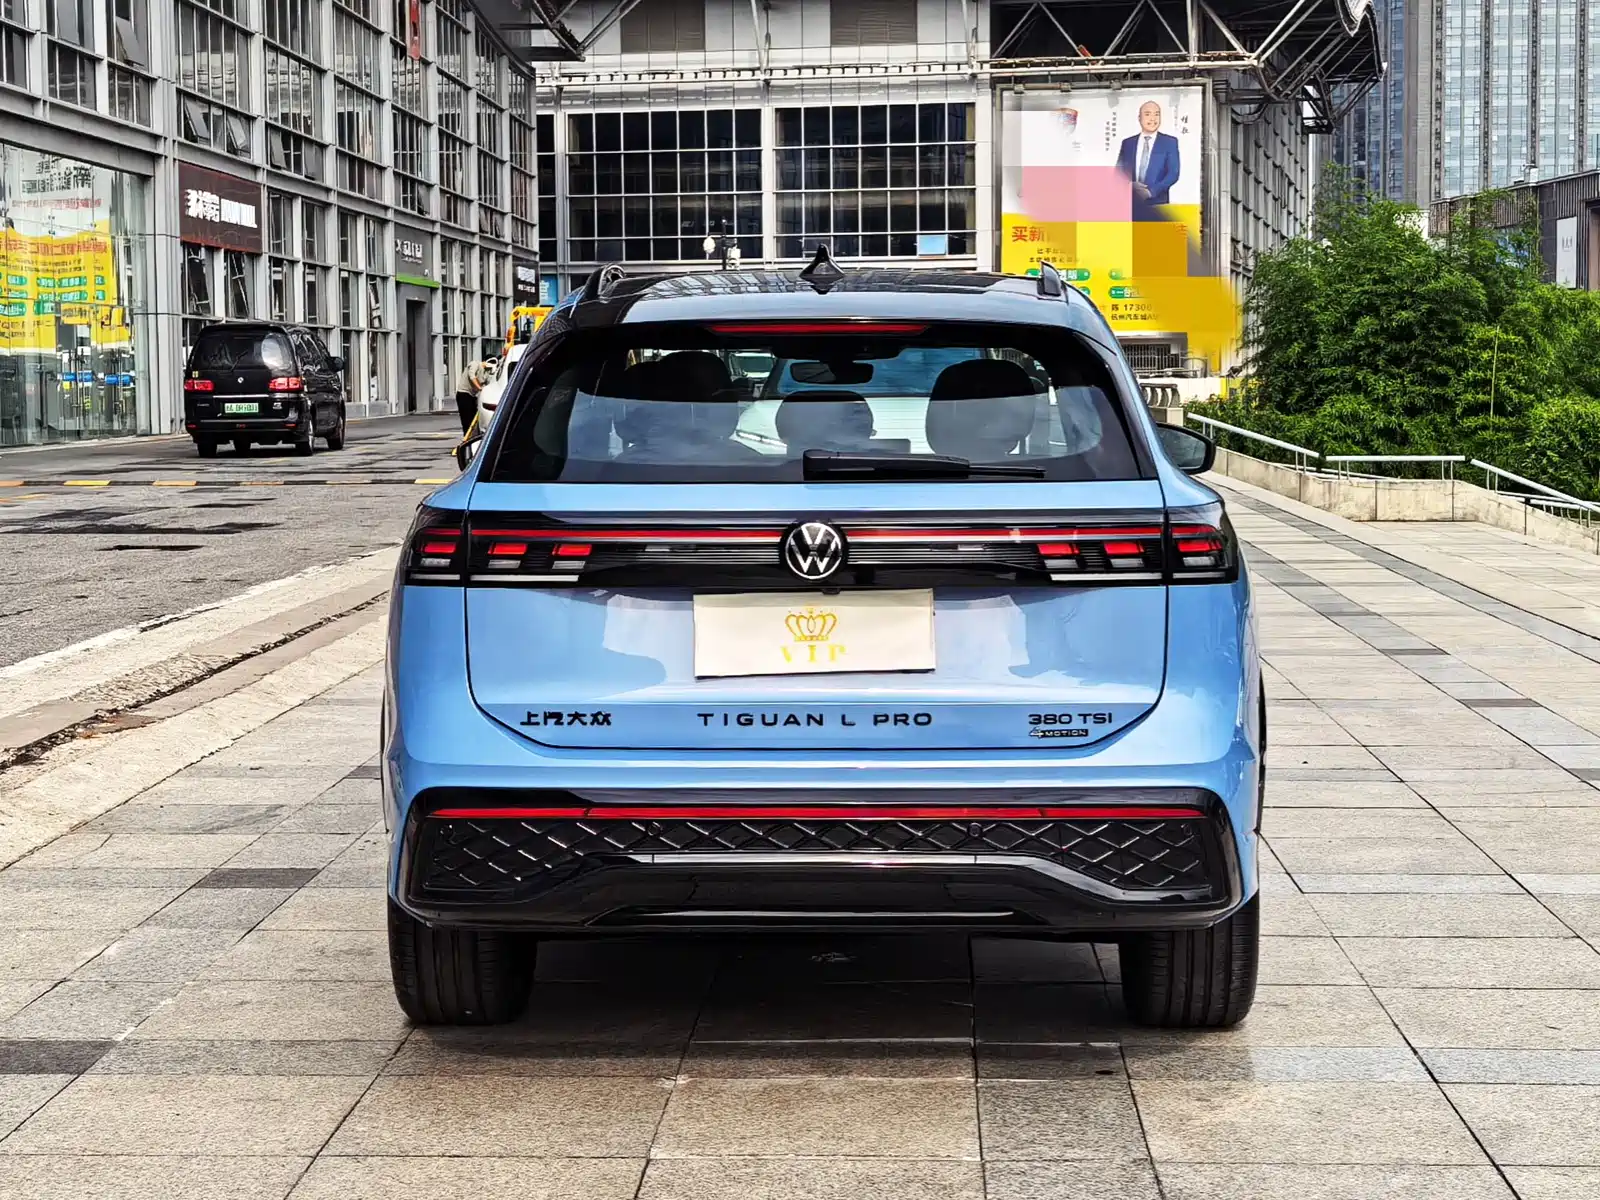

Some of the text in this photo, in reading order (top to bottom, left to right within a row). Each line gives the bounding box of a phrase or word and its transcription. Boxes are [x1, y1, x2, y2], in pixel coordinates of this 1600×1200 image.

[780, 644, 846, 662] VIP
[520, 711, 612, 726] 上汽大众
[697, 713, 932, 726] TIGUAN L PRO
[1028, 712, 1112, 724] 380 TSI
[1029, 727, 1088, 739] 4MOTION
